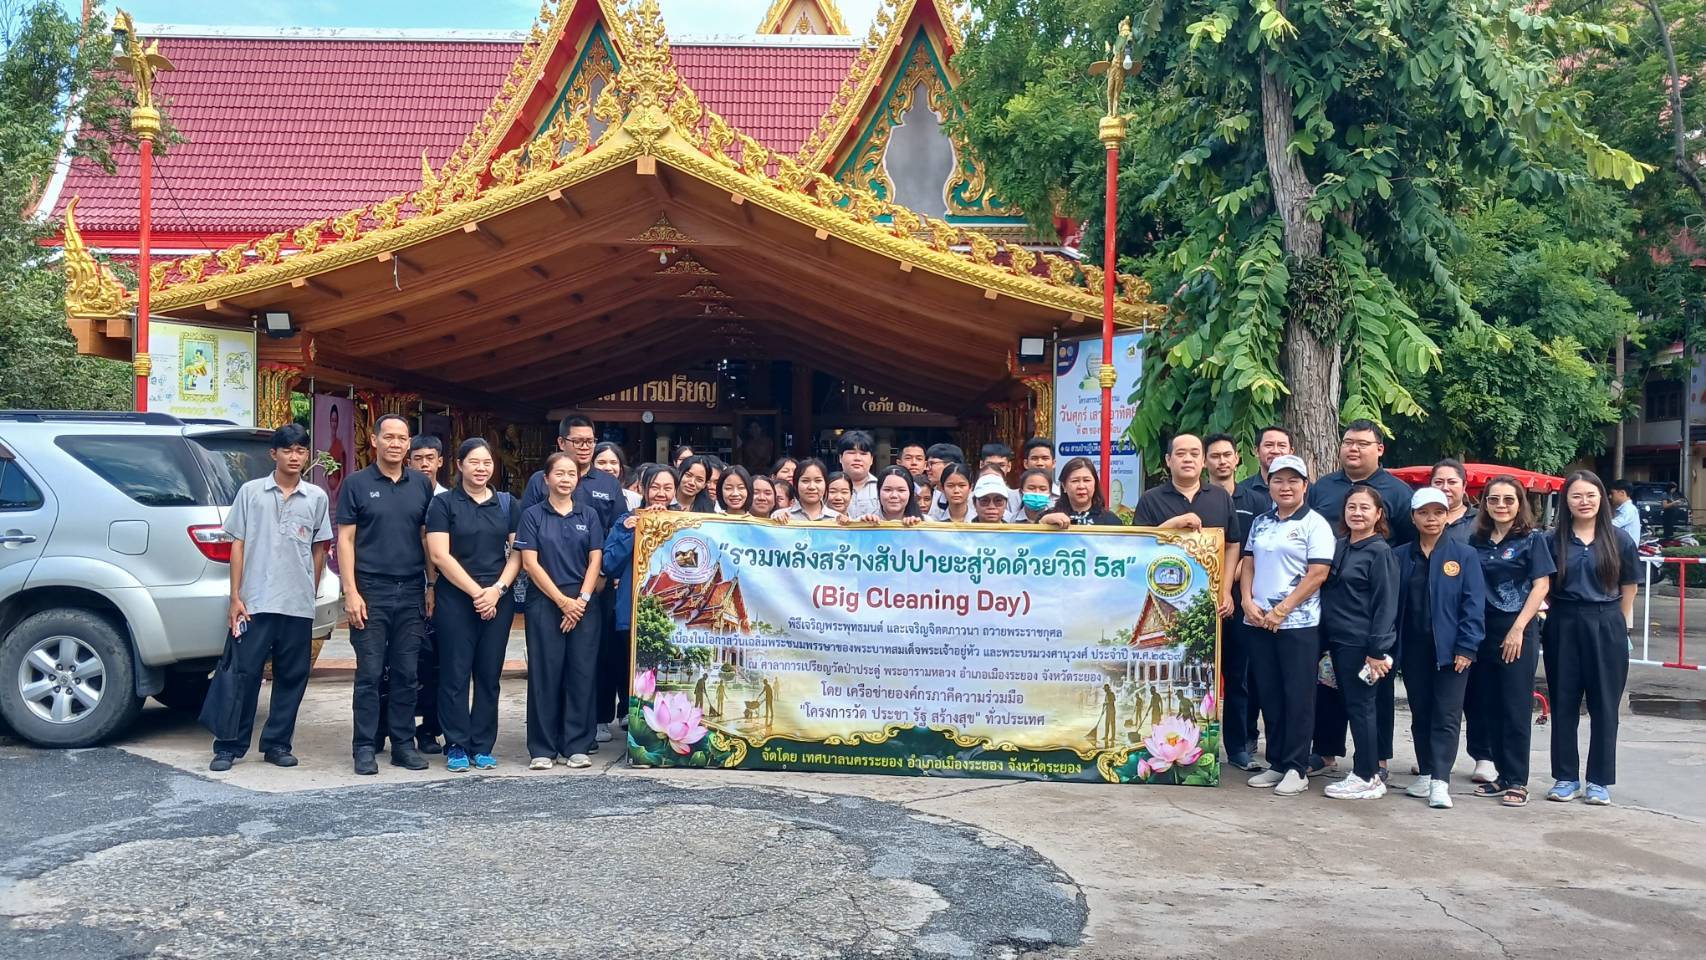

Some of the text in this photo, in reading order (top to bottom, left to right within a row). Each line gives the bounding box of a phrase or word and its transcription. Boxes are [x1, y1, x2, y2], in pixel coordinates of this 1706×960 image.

[812, 585, 1031, 617] (Big Cleaning Day)
[788, 617, 1063, 642] พิธีเจริญพระพุทธมนต์ และเจริญจิตตภาวนา ถวายพระราชกุศล
[984, 647, 1088, 663] และพระบรมวงศานุวงศ์
[1092, 648, 1129, 660] ประจำปี
[761, 661, 881, 680] ศาลาการเปรียญวัดป่าประดู่
[884, 667, 956, 679] พระอารามหลวง
[960, 667, 1038, 681] อำเภอเมืองระยอง
[1042, 668, 1102, 682] จังหวัดระยอง
[821, 681, 1024, 705] โดย เครือข่ายองค์กรภาคีความร่วมมือ
[800, 702, 1045, 728] "โครงการวัด ประชา รัฐ สร้างสุข" ทั่วประเทศ
[762, 747, 1082, 774] จัดโดย เทศบาลนครระยอง อำเภอเมืองระยอง จังหวัดระยอง
